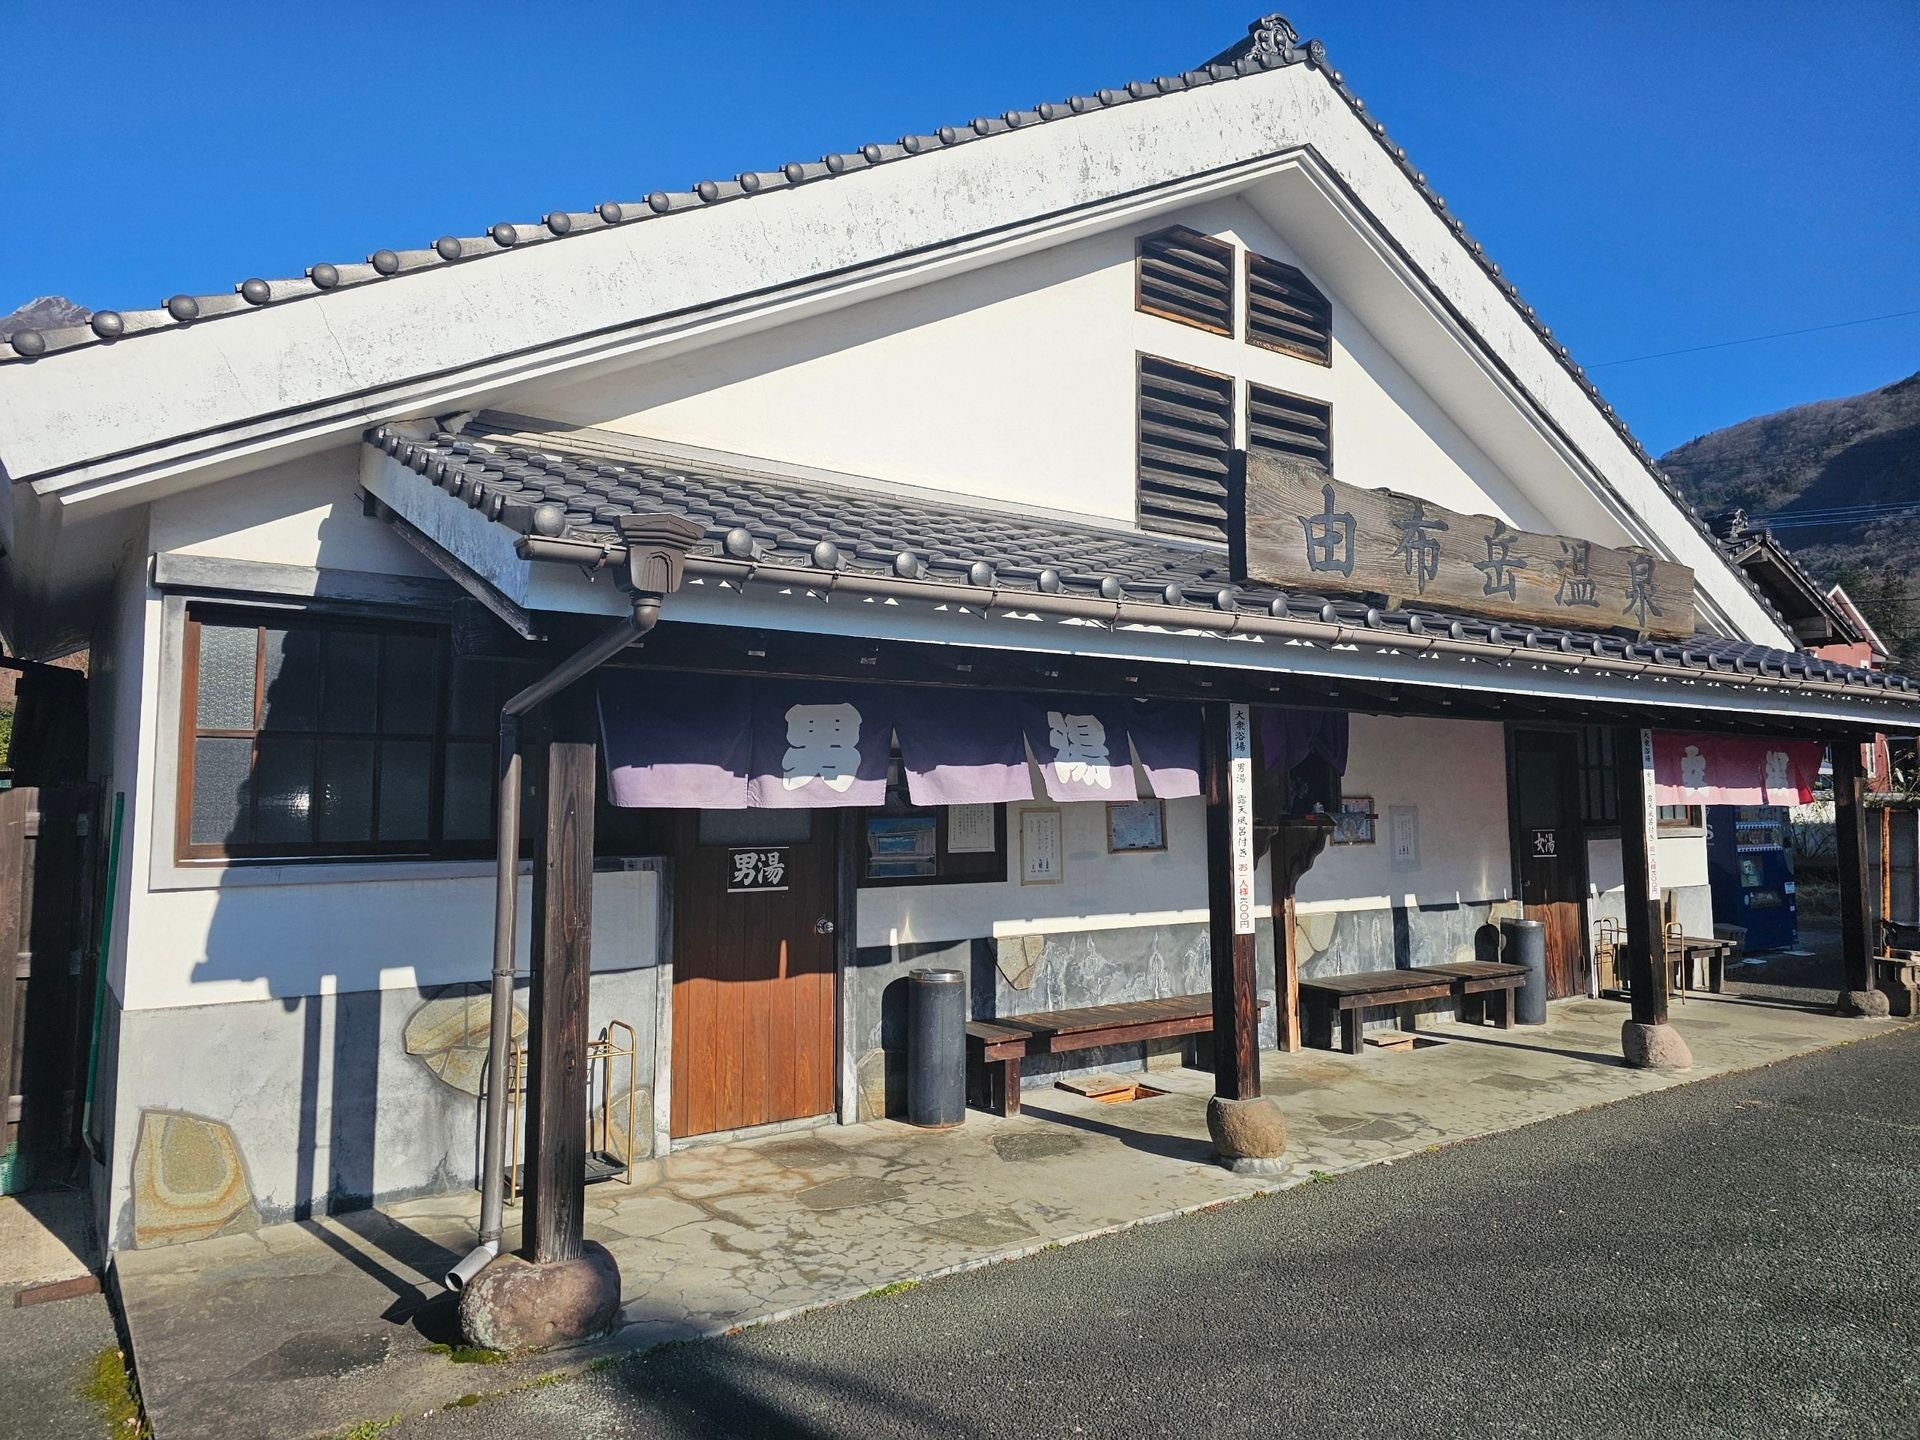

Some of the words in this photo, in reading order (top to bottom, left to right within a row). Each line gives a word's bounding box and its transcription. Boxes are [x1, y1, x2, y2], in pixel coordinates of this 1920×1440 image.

[1298, 483, 1663, 628] 由布岳温泉
[1534, 832, 1555, 853] 女湯
[732, 851, 785, 886] 男湯
